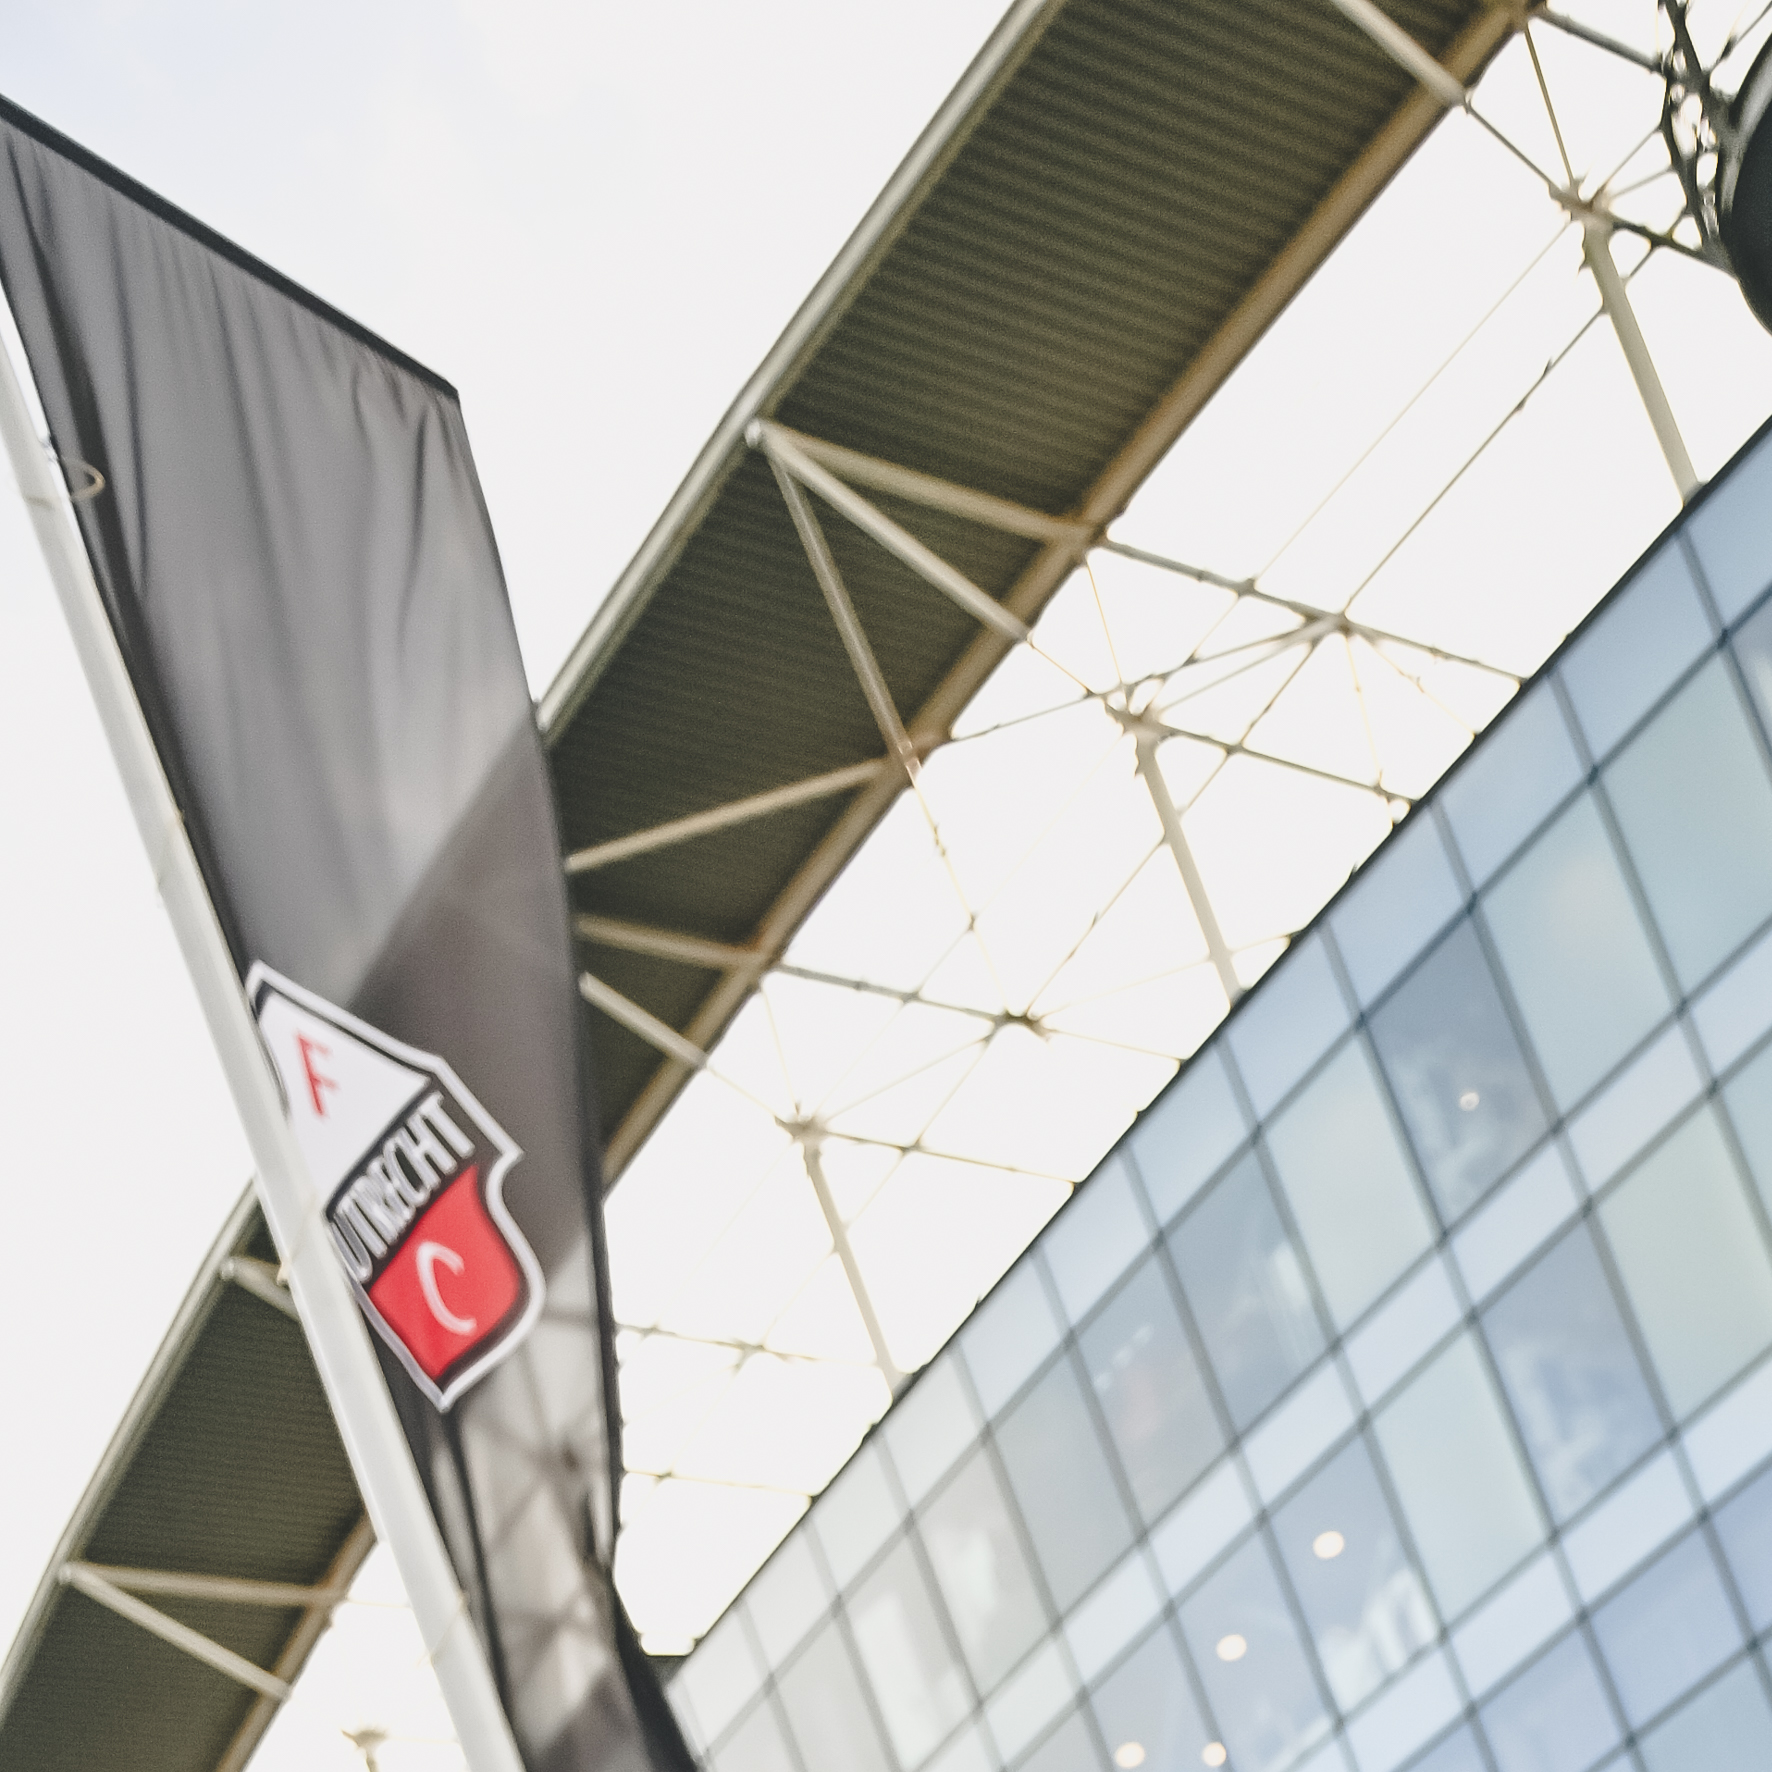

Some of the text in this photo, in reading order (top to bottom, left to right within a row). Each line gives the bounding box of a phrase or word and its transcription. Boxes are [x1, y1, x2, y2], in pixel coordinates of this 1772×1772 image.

[297, 1028, 339, 1120] F
[332, 1090, 475, 1284] UTRECHT
[416, 1240, 477, 1336] C
